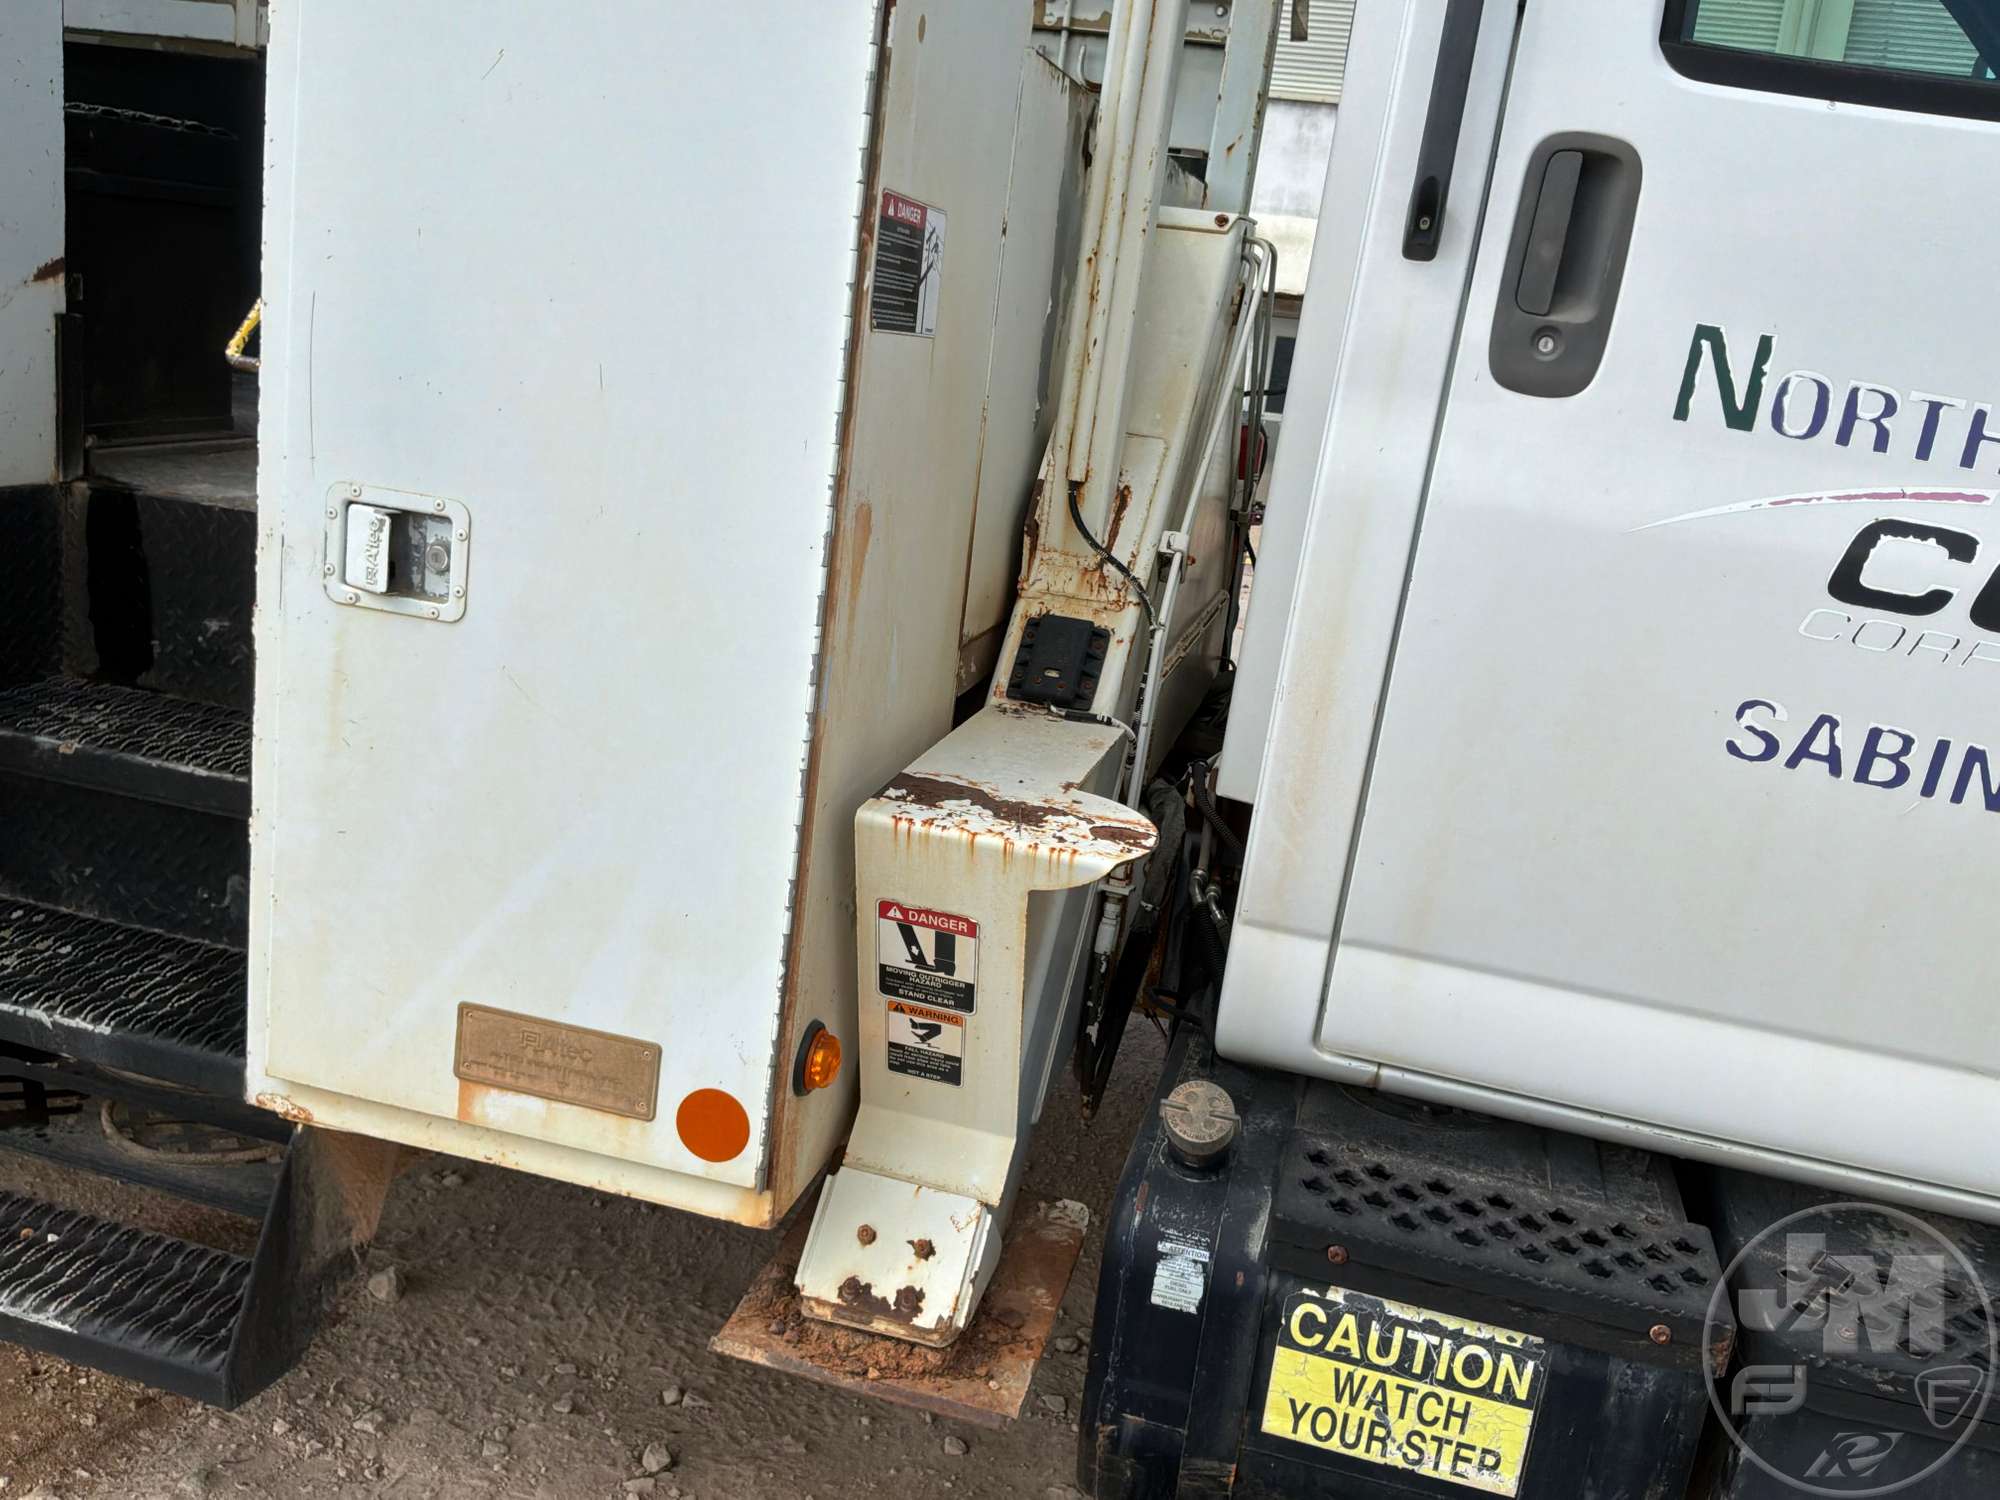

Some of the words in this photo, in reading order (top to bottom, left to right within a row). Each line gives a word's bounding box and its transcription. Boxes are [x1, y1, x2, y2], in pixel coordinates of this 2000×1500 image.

[908, 910, 968, 933] DANGER
[886, 966, 917, 978] MOVING
[919, 973, 965, 988] OUTRIGGER
[909, 977, 942, 989] HAZARD
[899, 988, 925, 1000] STAND
[927, 995, 955, 1006] CLEAR
[909, 1006, 959, 1024] WARNING
[1290, 1302, 1535, 1401] CAUTION
[1333, 1367, 1472, 1436] WATCH
[1288, 1398, 1388, 1458] YOUR
[1401, 1430, 1502, 1480] STEP
